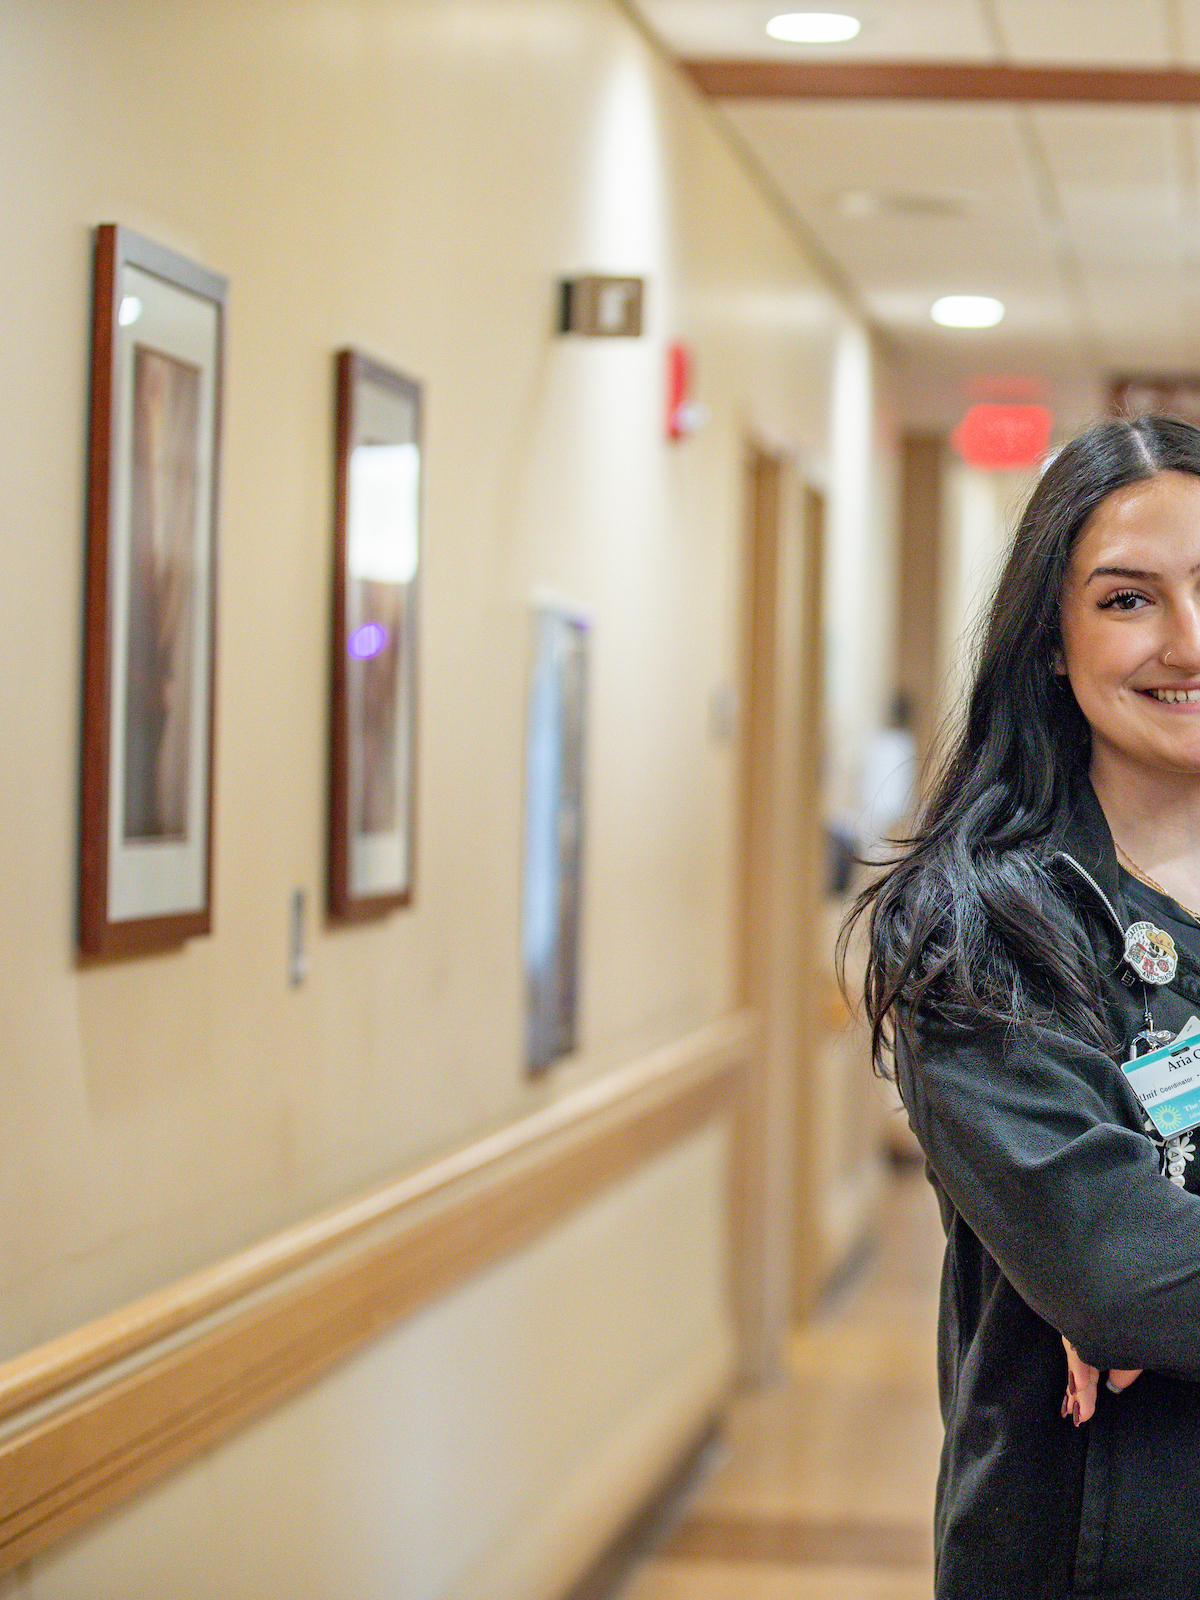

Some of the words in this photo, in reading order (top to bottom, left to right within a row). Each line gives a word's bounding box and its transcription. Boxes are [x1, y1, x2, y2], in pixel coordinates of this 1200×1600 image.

[1167, 1055, 1193, 1072] Aria
[1139, 1089, 1158, 1102] Unit
[1159, 1075, 1194, 1094] Coordinator
[1182, 1099, 1198, 1112] The
